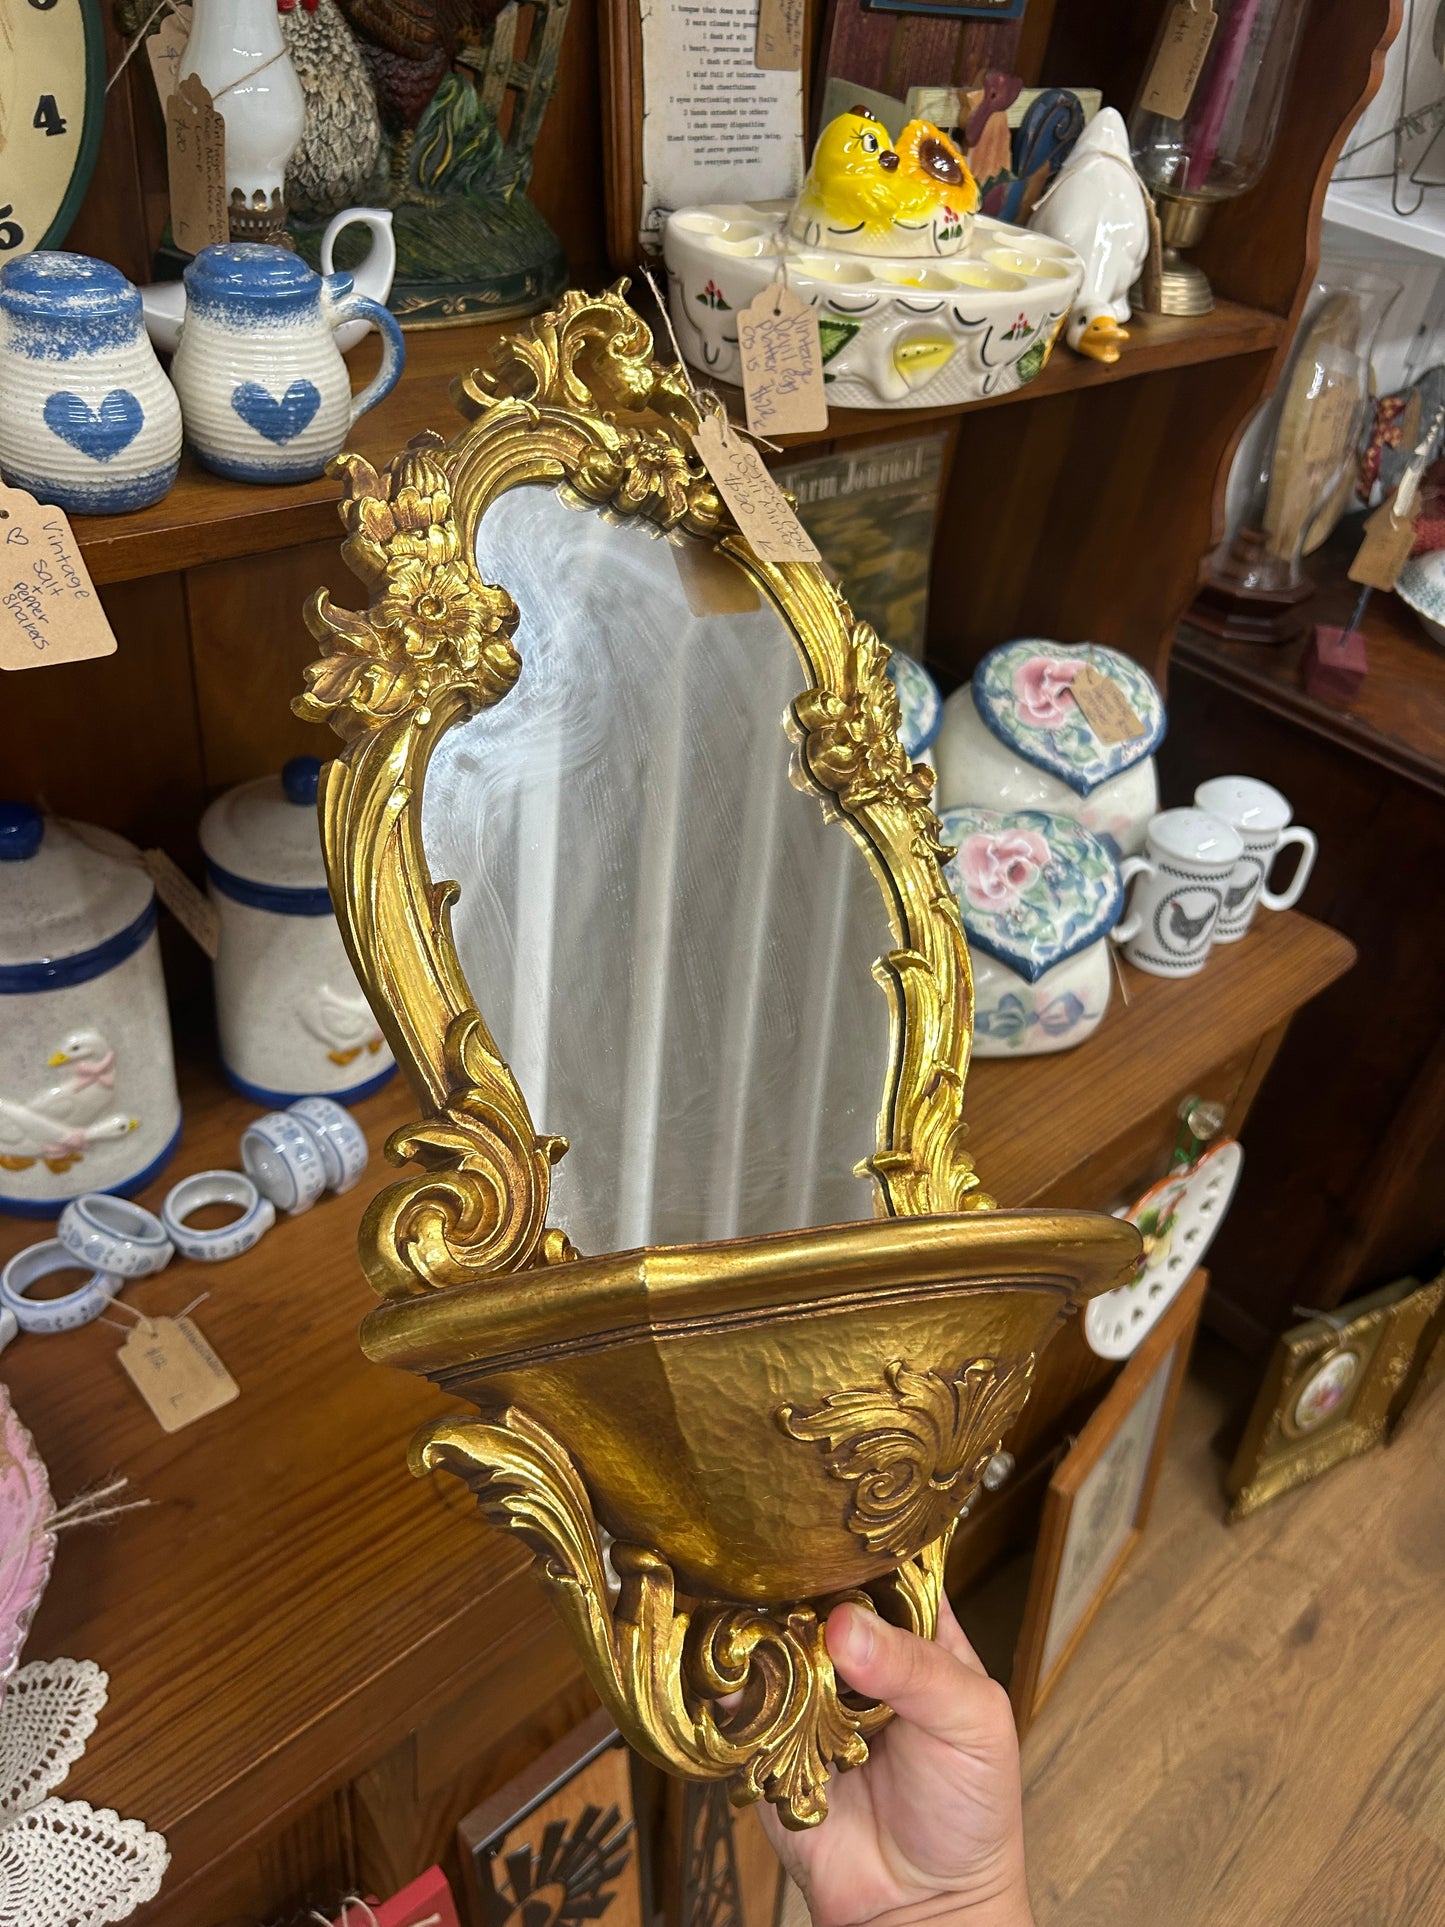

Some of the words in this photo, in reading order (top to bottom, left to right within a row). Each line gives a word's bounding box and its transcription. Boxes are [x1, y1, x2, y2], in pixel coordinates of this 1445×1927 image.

[33, 95, 67, 137] 4
[729, 453, 761, 493] Wall
[758, 500, 795, 549] Mirror
[841, 445, 924, 494] Journal
[43, 521, 90, 599] Vintage
